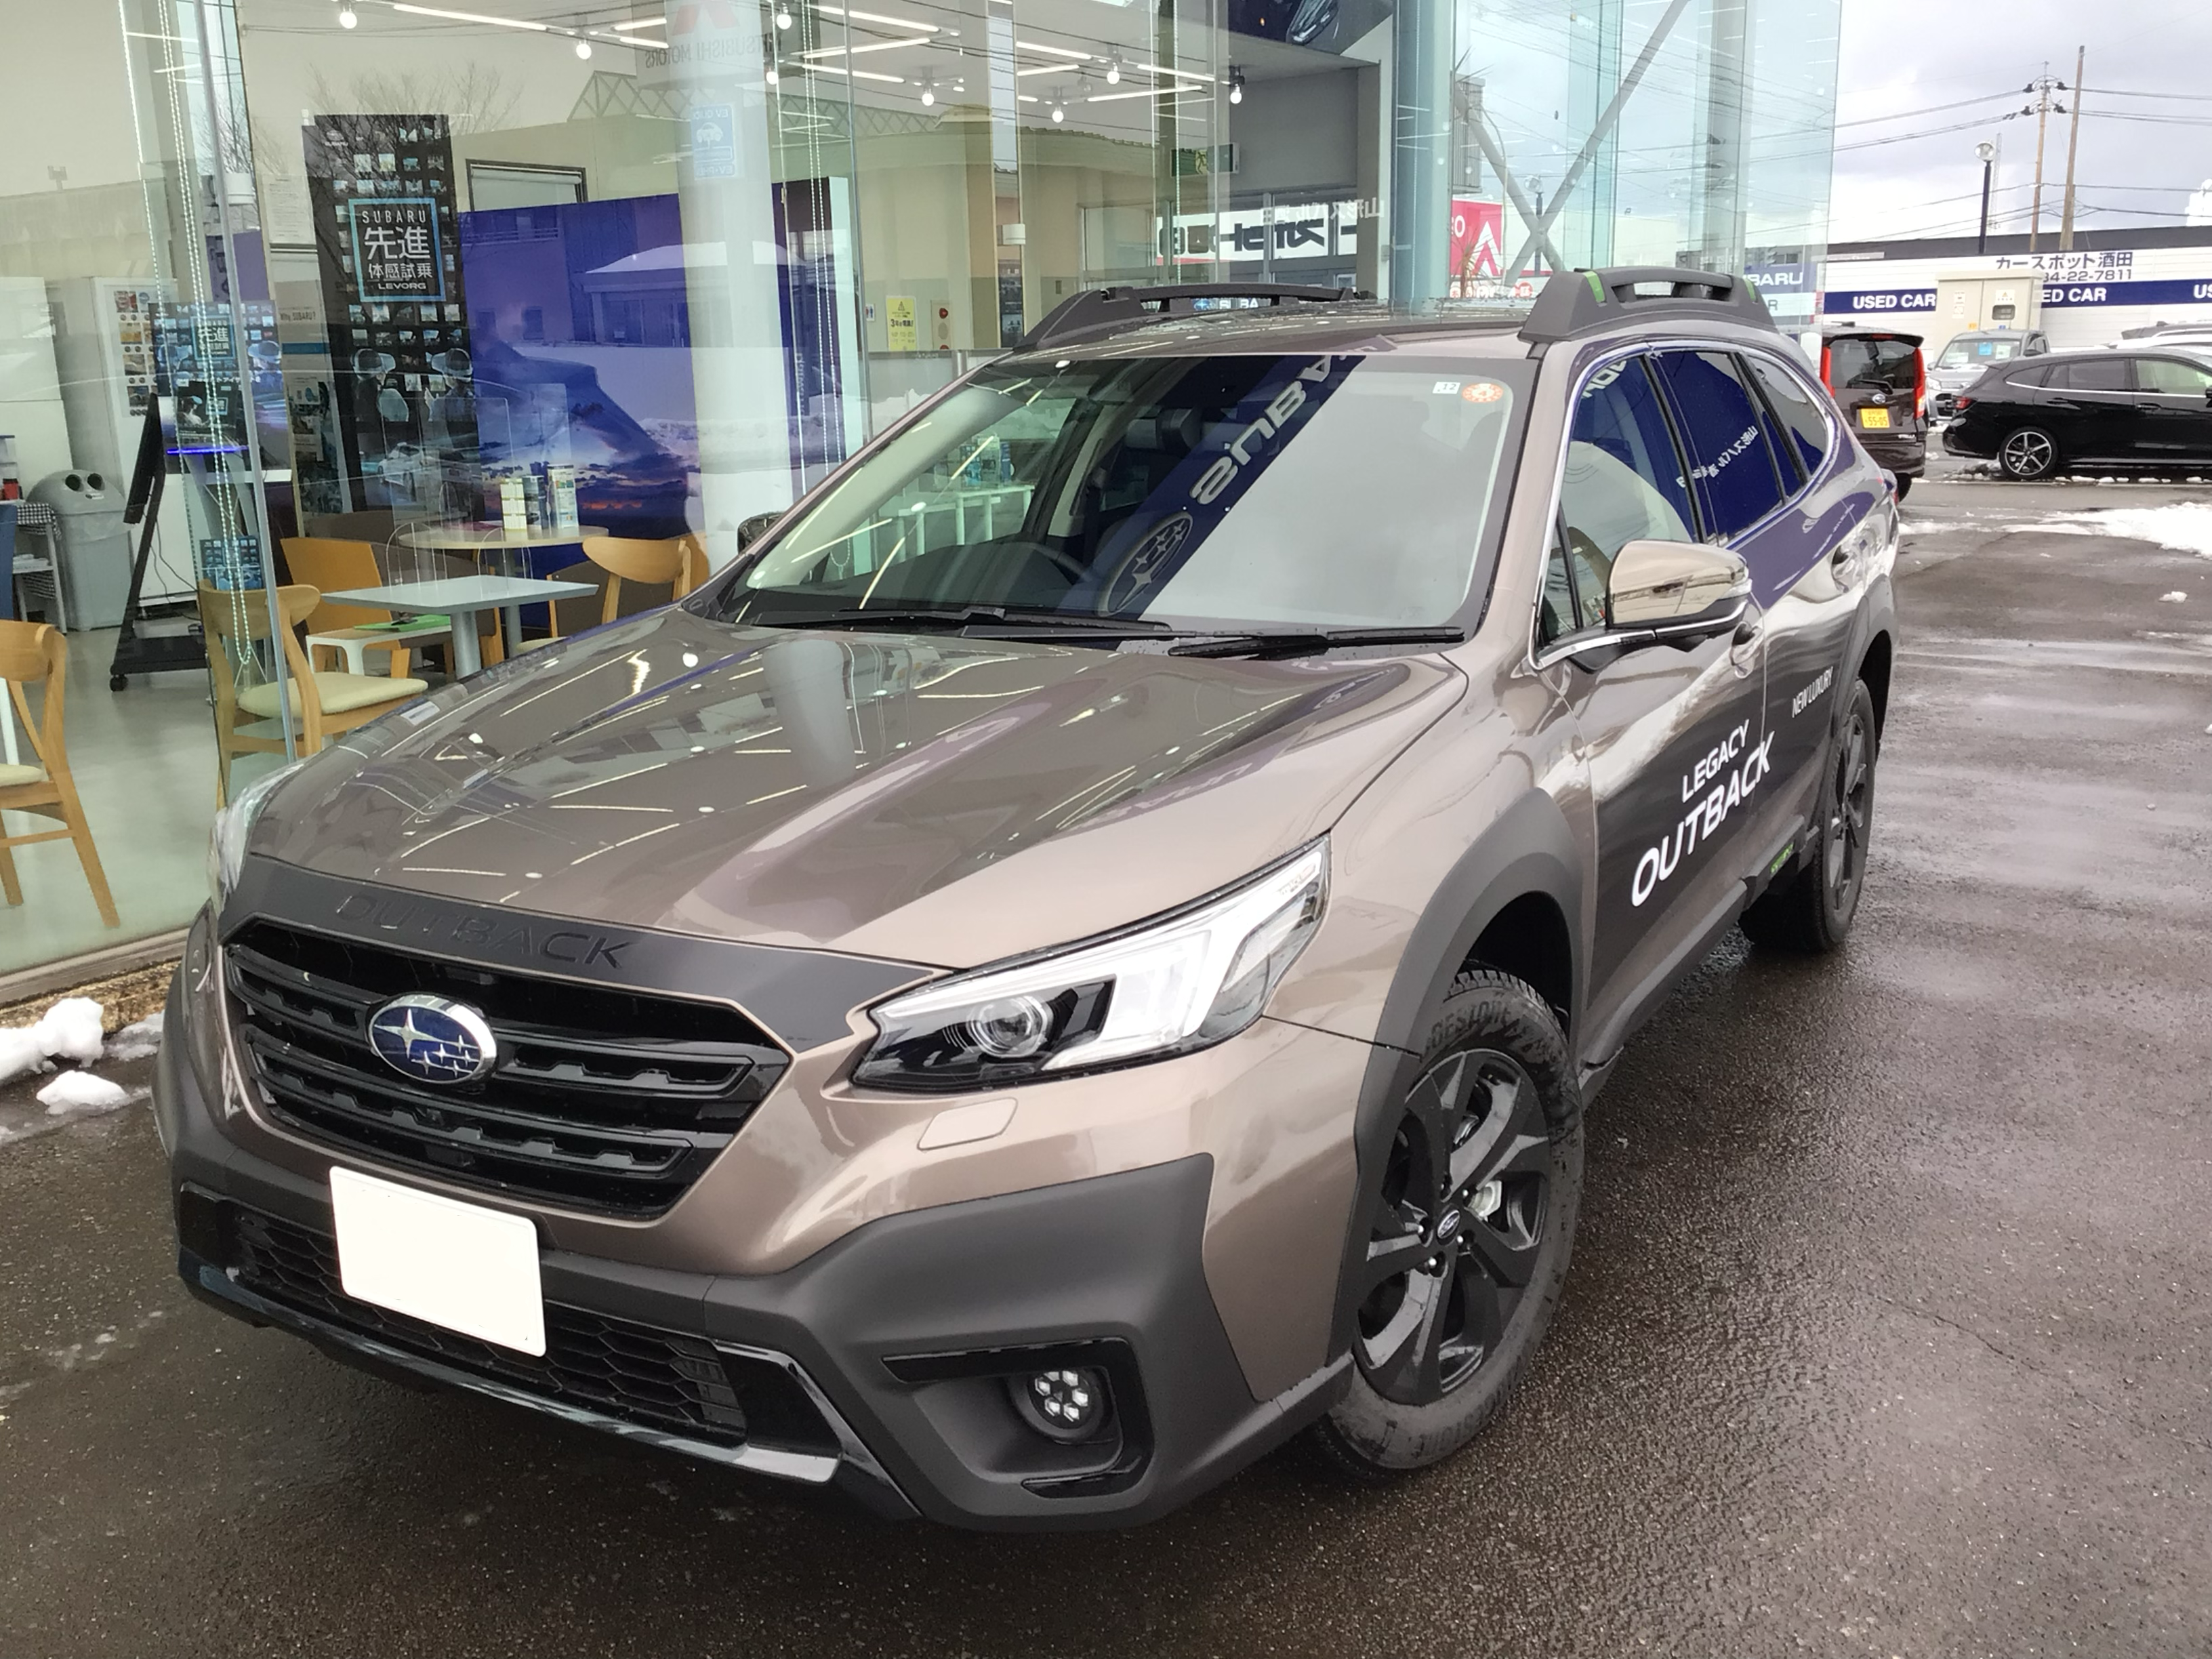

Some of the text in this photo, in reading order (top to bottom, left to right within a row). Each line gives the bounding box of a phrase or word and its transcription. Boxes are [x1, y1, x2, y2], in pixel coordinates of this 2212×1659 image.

[361, 209, 426, 224] SUBARU
[364, 226, 430, 260] 先進
[1996, 251, 2133, 270] カースポット酒田
[368, 262, 433, 279] 体感試乗
[1742, 272, 1803, 287] BARU
[377, 282, 426, 290] LEVORG
[2043, 287, 2107, 303] ED CAR
[1853, 294, 1898, 309] USED
[1900, 293, 1937, 308] CAR
[1791, 687, 1809, 718] NEW
[1682, 719, 1750, 803] LEGACY
[1631, 731, 1776, 907] OUTBACK
[336, 894, 636, 970] OUTBACK
